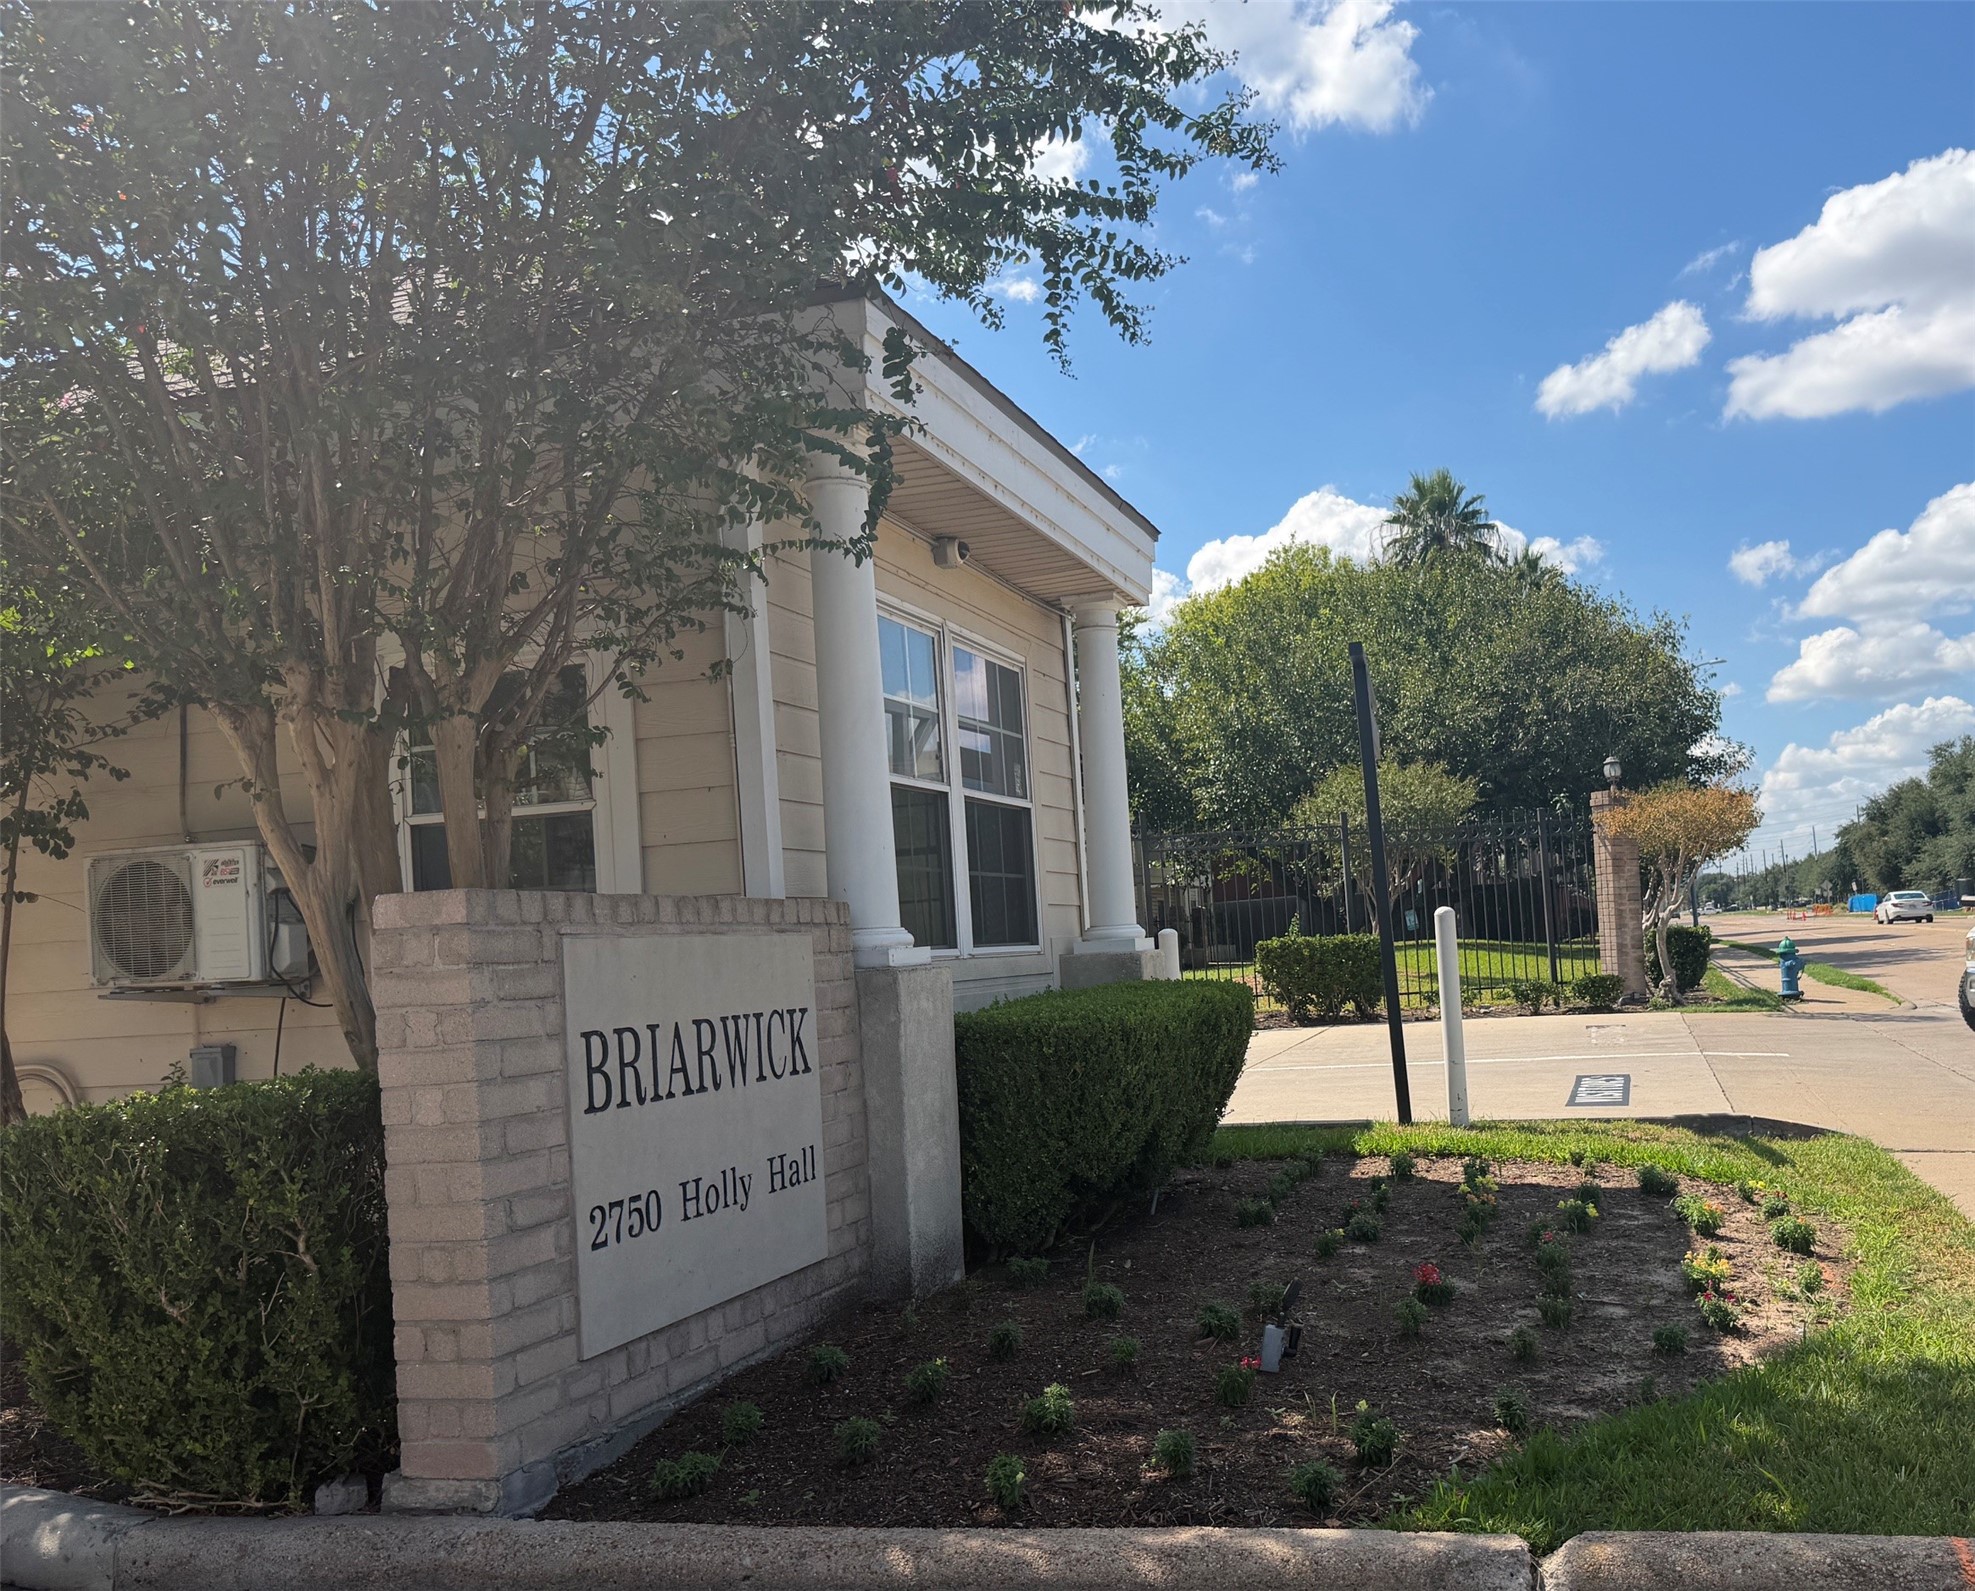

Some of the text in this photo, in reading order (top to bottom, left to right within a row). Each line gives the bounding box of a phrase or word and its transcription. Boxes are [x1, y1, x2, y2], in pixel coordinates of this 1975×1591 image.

[580, 1008, 812, 1115] BRIARWICK
[589, 1145, 817, 1252] 2750 Holly Hall
